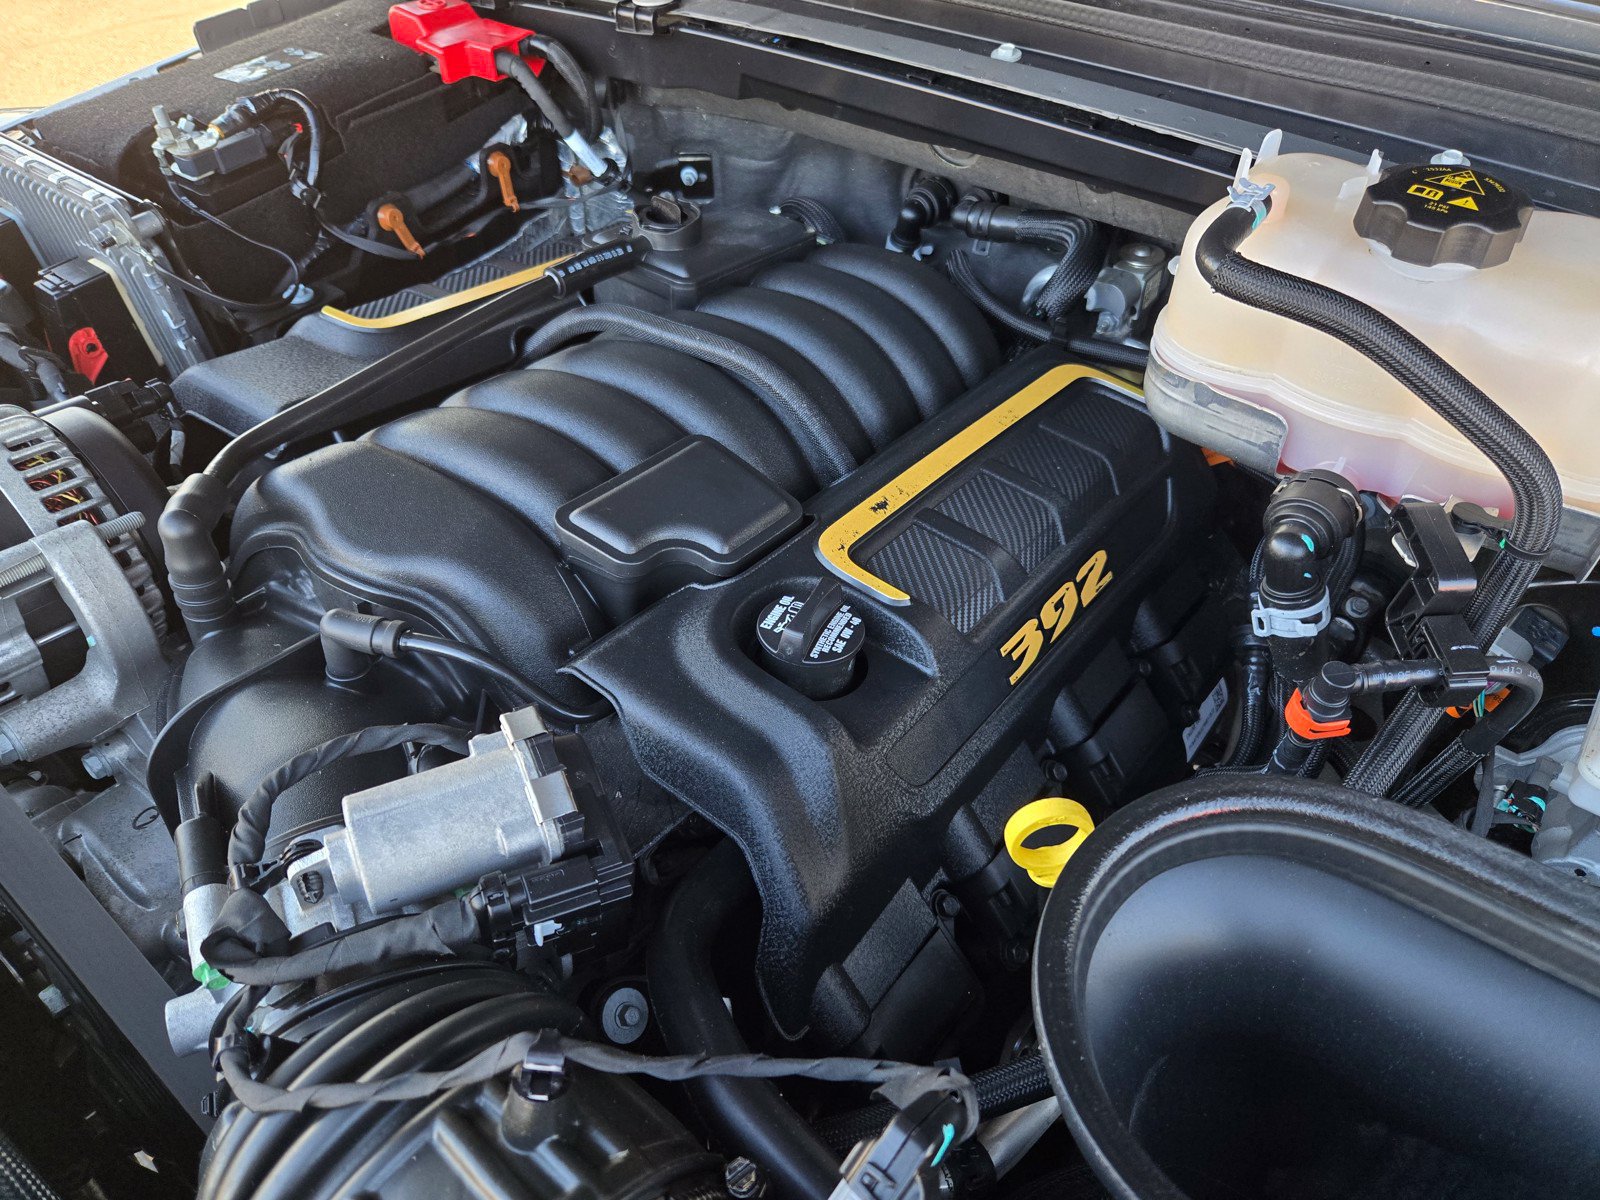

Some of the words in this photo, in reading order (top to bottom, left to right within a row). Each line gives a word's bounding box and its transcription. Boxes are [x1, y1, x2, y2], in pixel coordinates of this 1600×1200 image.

[760, 604, 787, 630] ENGINE
[779, 595, 795, 606] OIL
[810, 628, 832, 659] SYNTHETIC
[827, 611, 844, 629] ENGINE
[840, 604, 851, 613] OIL
[821, 612, 853, 653] RECOMMENDED
[1000, 550, 1113, 685] 392
[832, 638, 847, 653] SAE
